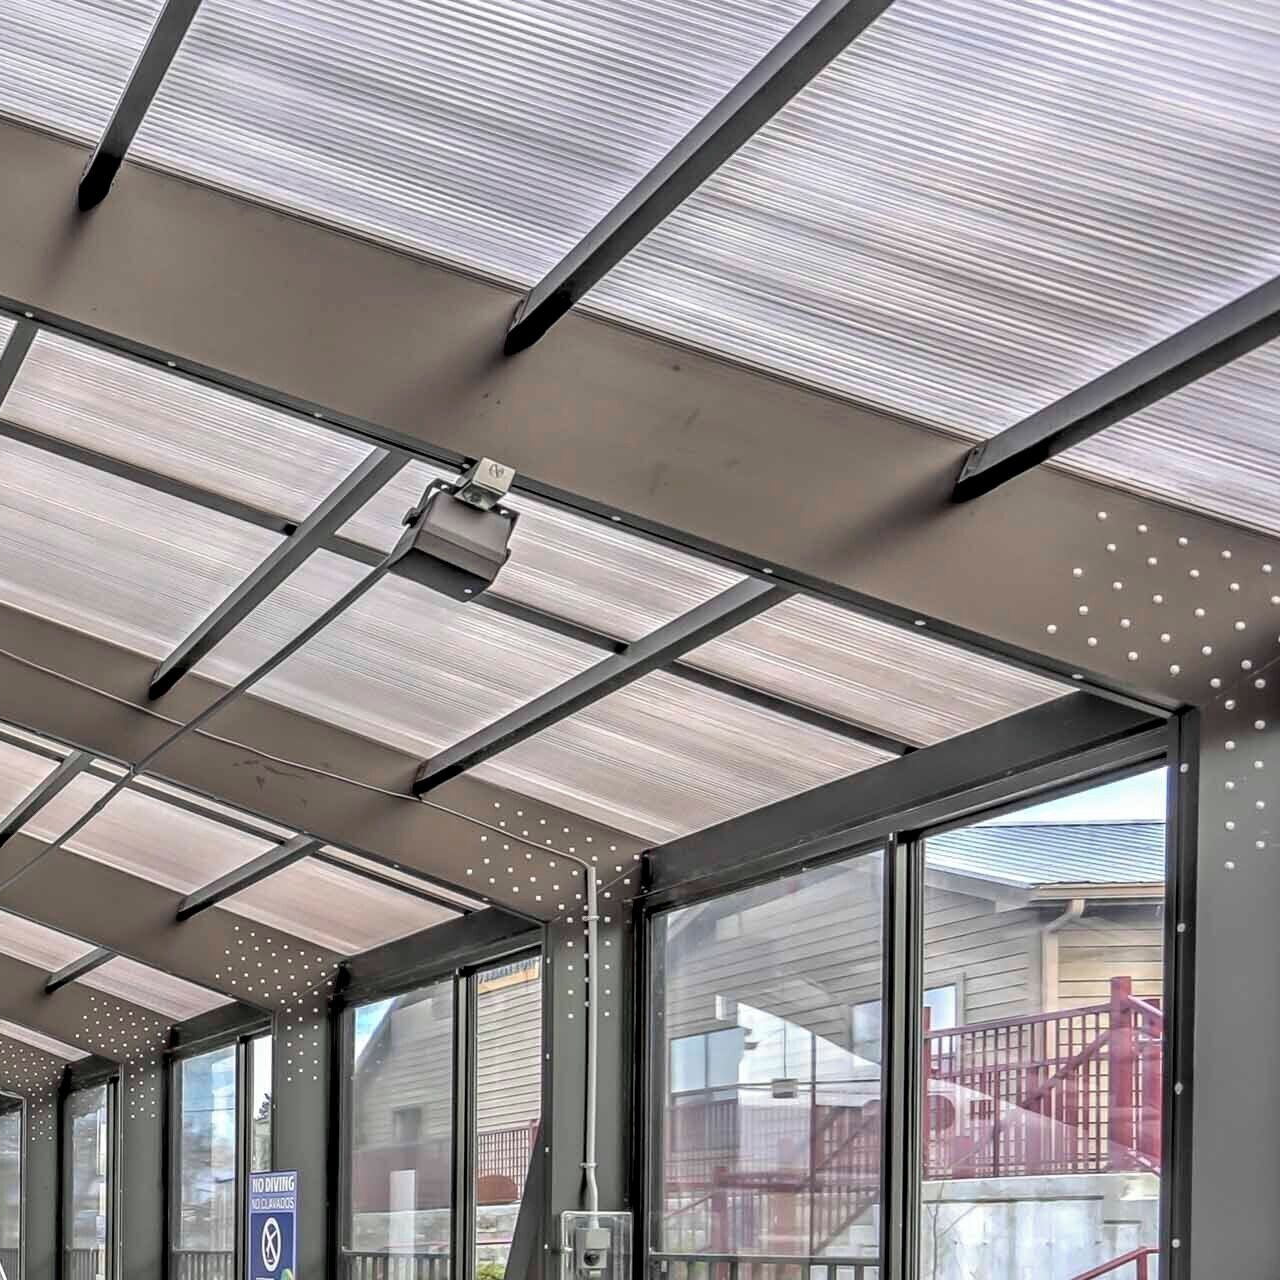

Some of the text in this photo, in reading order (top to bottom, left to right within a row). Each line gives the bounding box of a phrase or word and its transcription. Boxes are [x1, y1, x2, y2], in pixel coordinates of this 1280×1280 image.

[252, 1175, 295, 1193] NO DIVING
[251, 1197, 294, 1209] NO CLAVADOS
